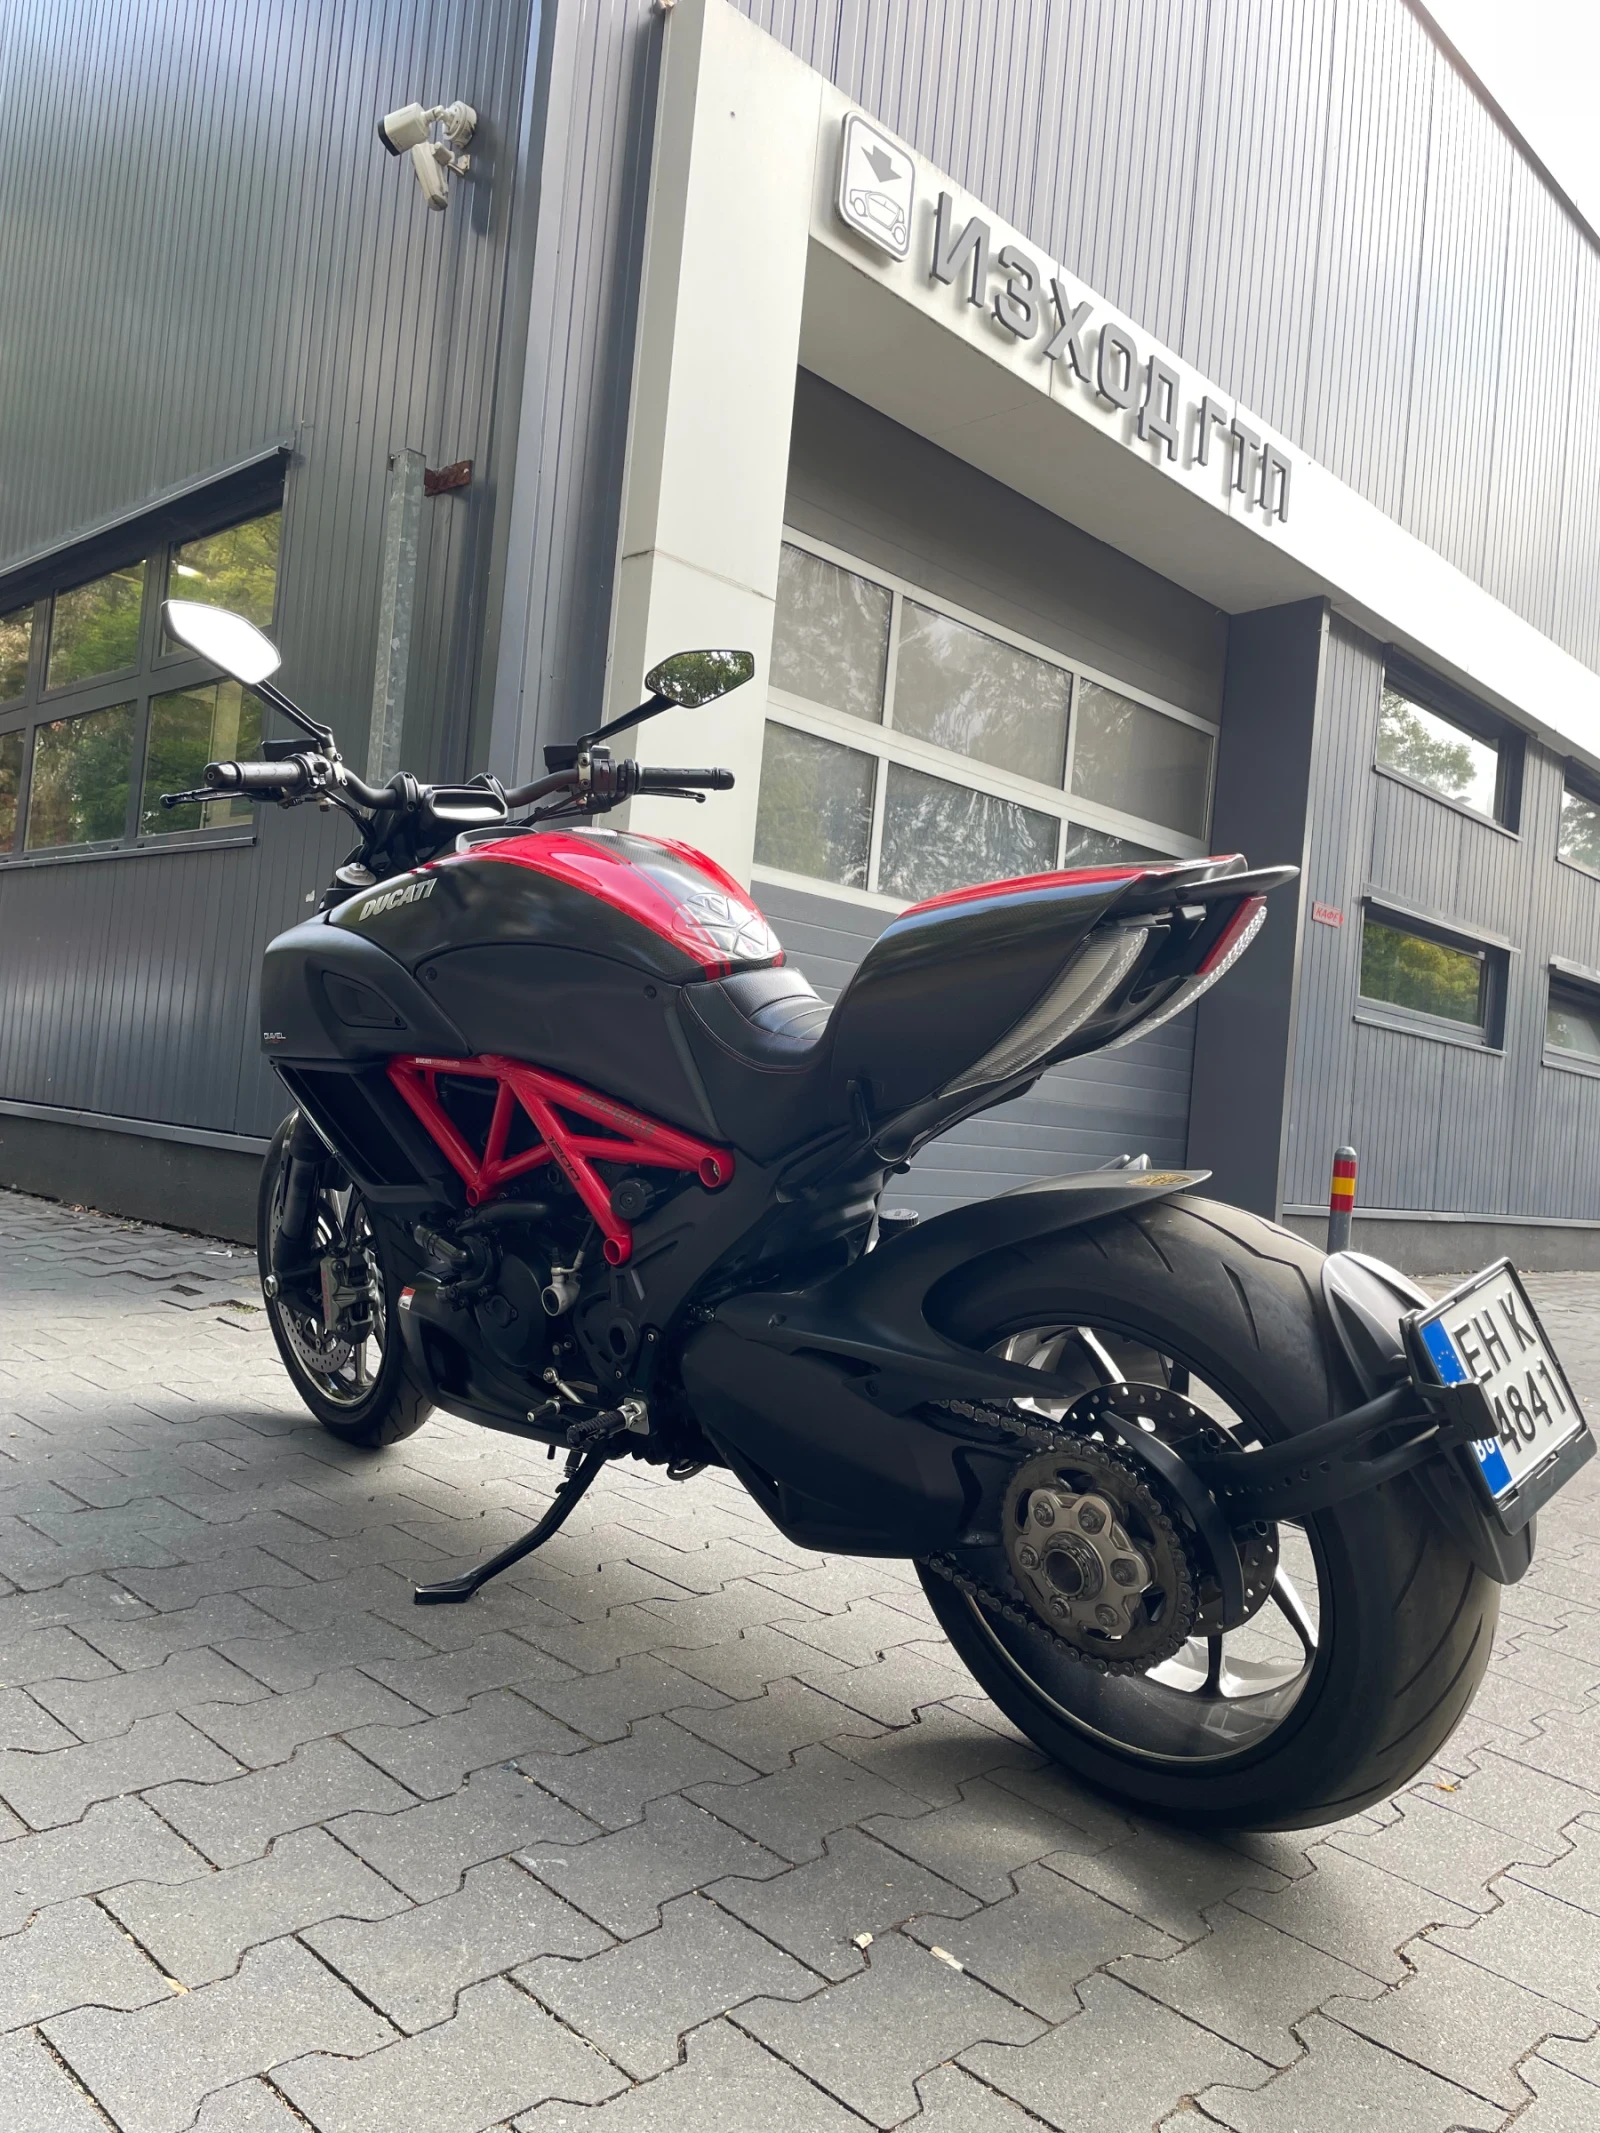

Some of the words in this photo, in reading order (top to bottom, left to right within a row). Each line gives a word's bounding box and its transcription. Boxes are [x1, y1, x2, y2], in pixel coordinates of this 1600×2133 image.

[931, 191, 1180, 462] ИЗХОД
[1198, 396, 1292, 523] ГТП
[358, 877, 438, 922] DUCATI
[1315, 907, 1339, 922] КАФЕ
[549, 1135, 581, 1181] 1200
[1450, 1306, 1511, 1384] EH
[1496, 1288, 1537, 1353] K
[1491, 1356, 1567, 1454] 4841
